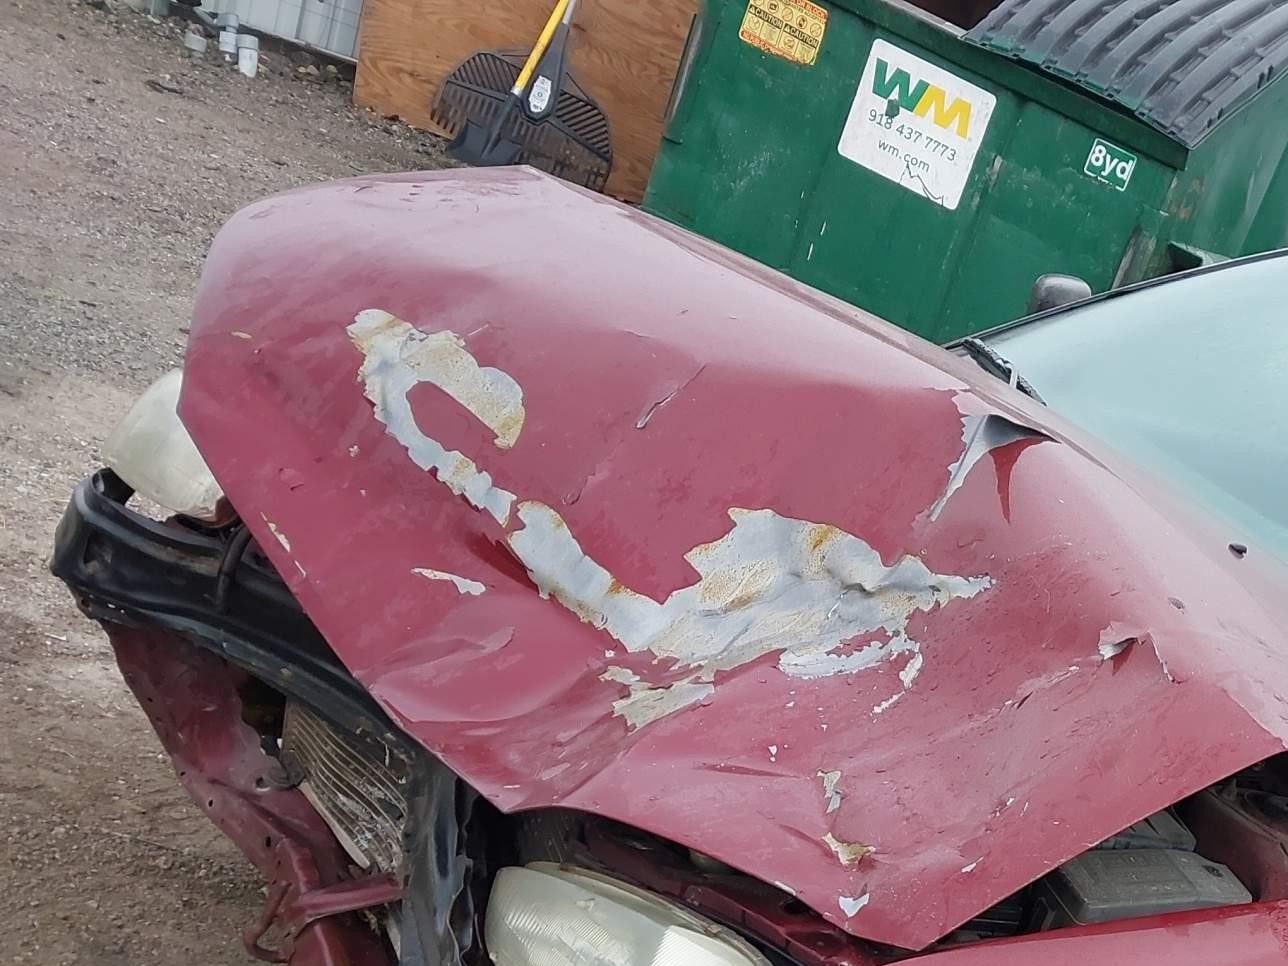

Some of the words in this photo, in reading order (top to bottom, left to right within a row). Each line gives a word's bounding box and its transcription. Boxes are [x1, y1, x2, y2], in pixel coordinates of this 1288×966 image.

[755, 8, 784, 29] CAUTION
[791, 26, 820, 48] CAUTION
[872, 57, 972, 139] WM
[868, 108, 894, 130] 918
[896, 124, 922, 143] 437
[926, 136, 957, 162] 7773
[878, 139, 930, 172] wm.com
[1091, 145, 1133, 180] 8yd
